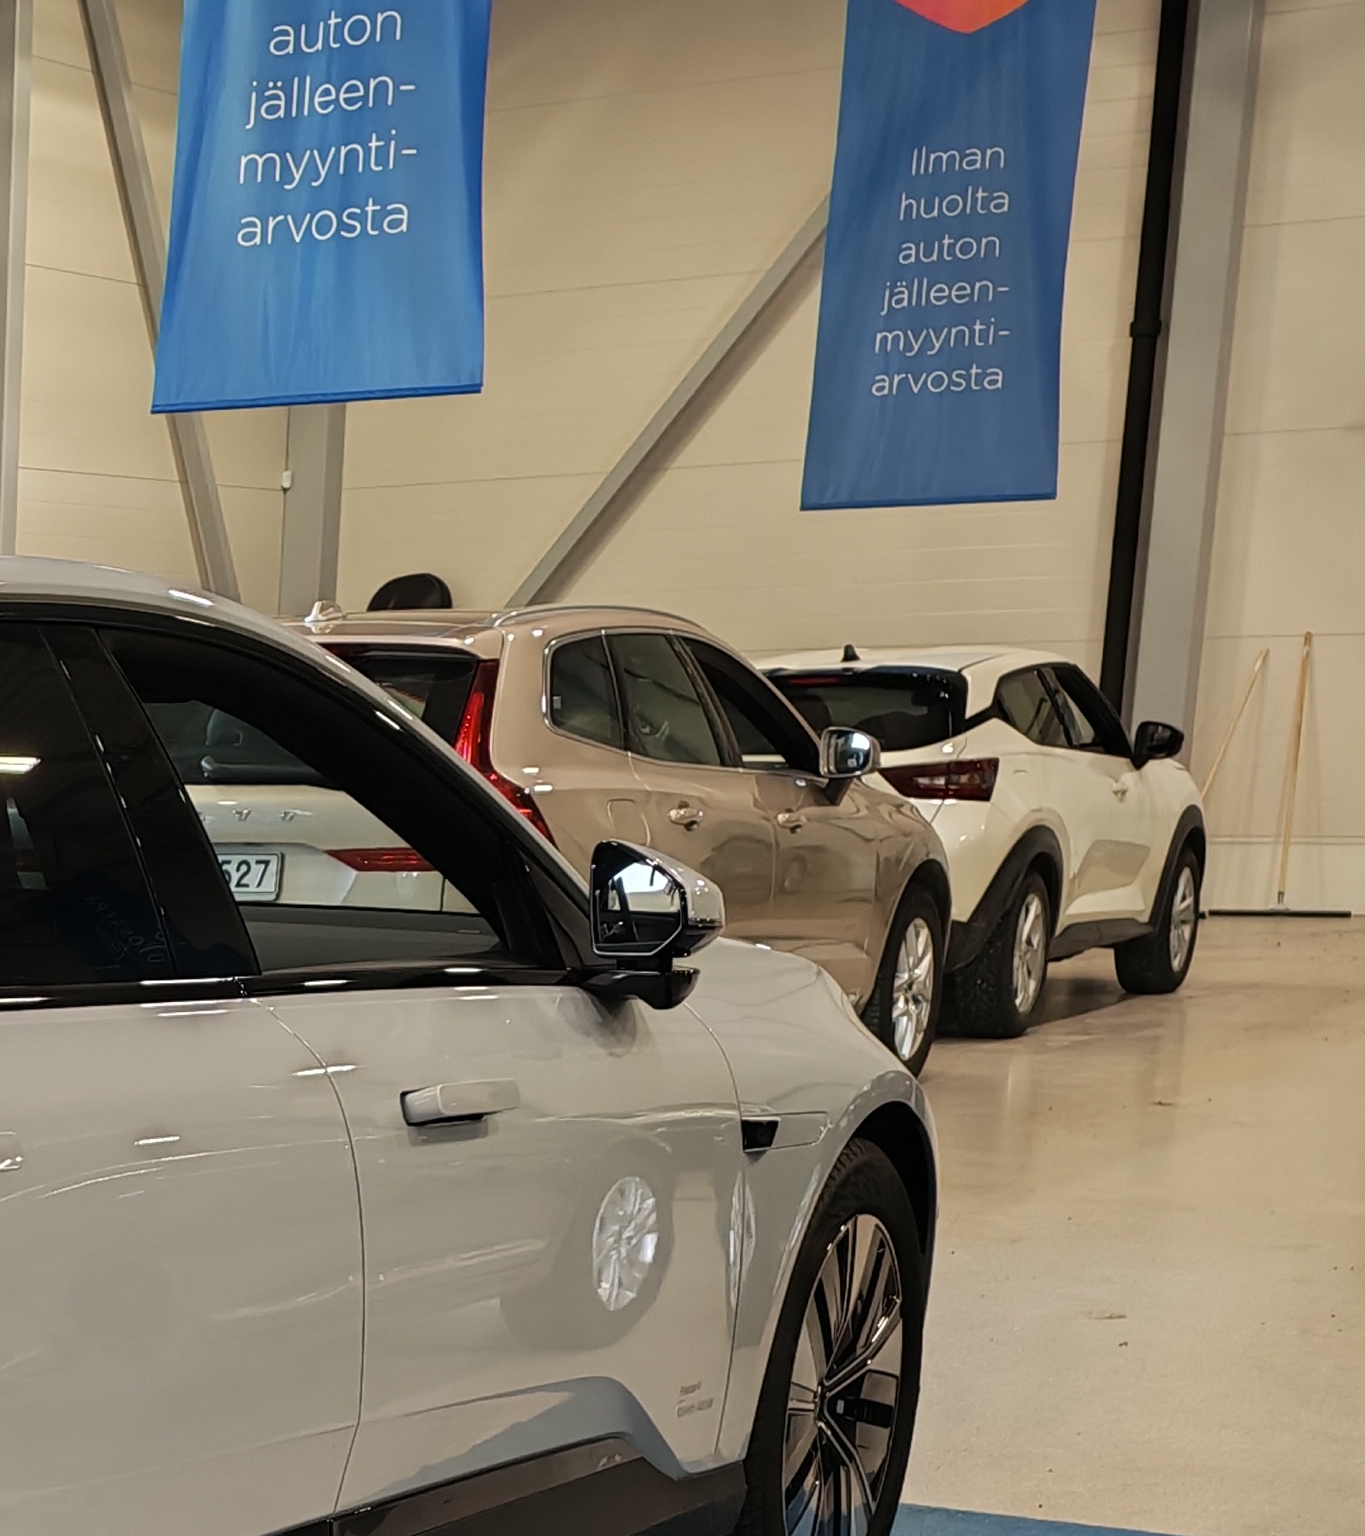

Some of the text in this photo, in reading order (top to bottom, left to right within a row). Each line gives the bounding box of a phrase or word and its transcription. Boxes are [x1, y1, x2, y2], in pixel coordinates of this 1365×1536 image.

[269, 9, 402, 56] auton
[244, 74, 416, 130] jälleen-
[238, 129, 418, 190] myynti-
[910, 145, 1006, 176] Ilman
[236, 196, 409, 247] arvosta
[898, 184, 1010, 222] huolta
[898, 232, 1001, 265] auton
[880, 276, 1011, 316] jälleen-
[874, 316, 1011, 357] myynti-
[871, 362, 1004, 397] arvosta
